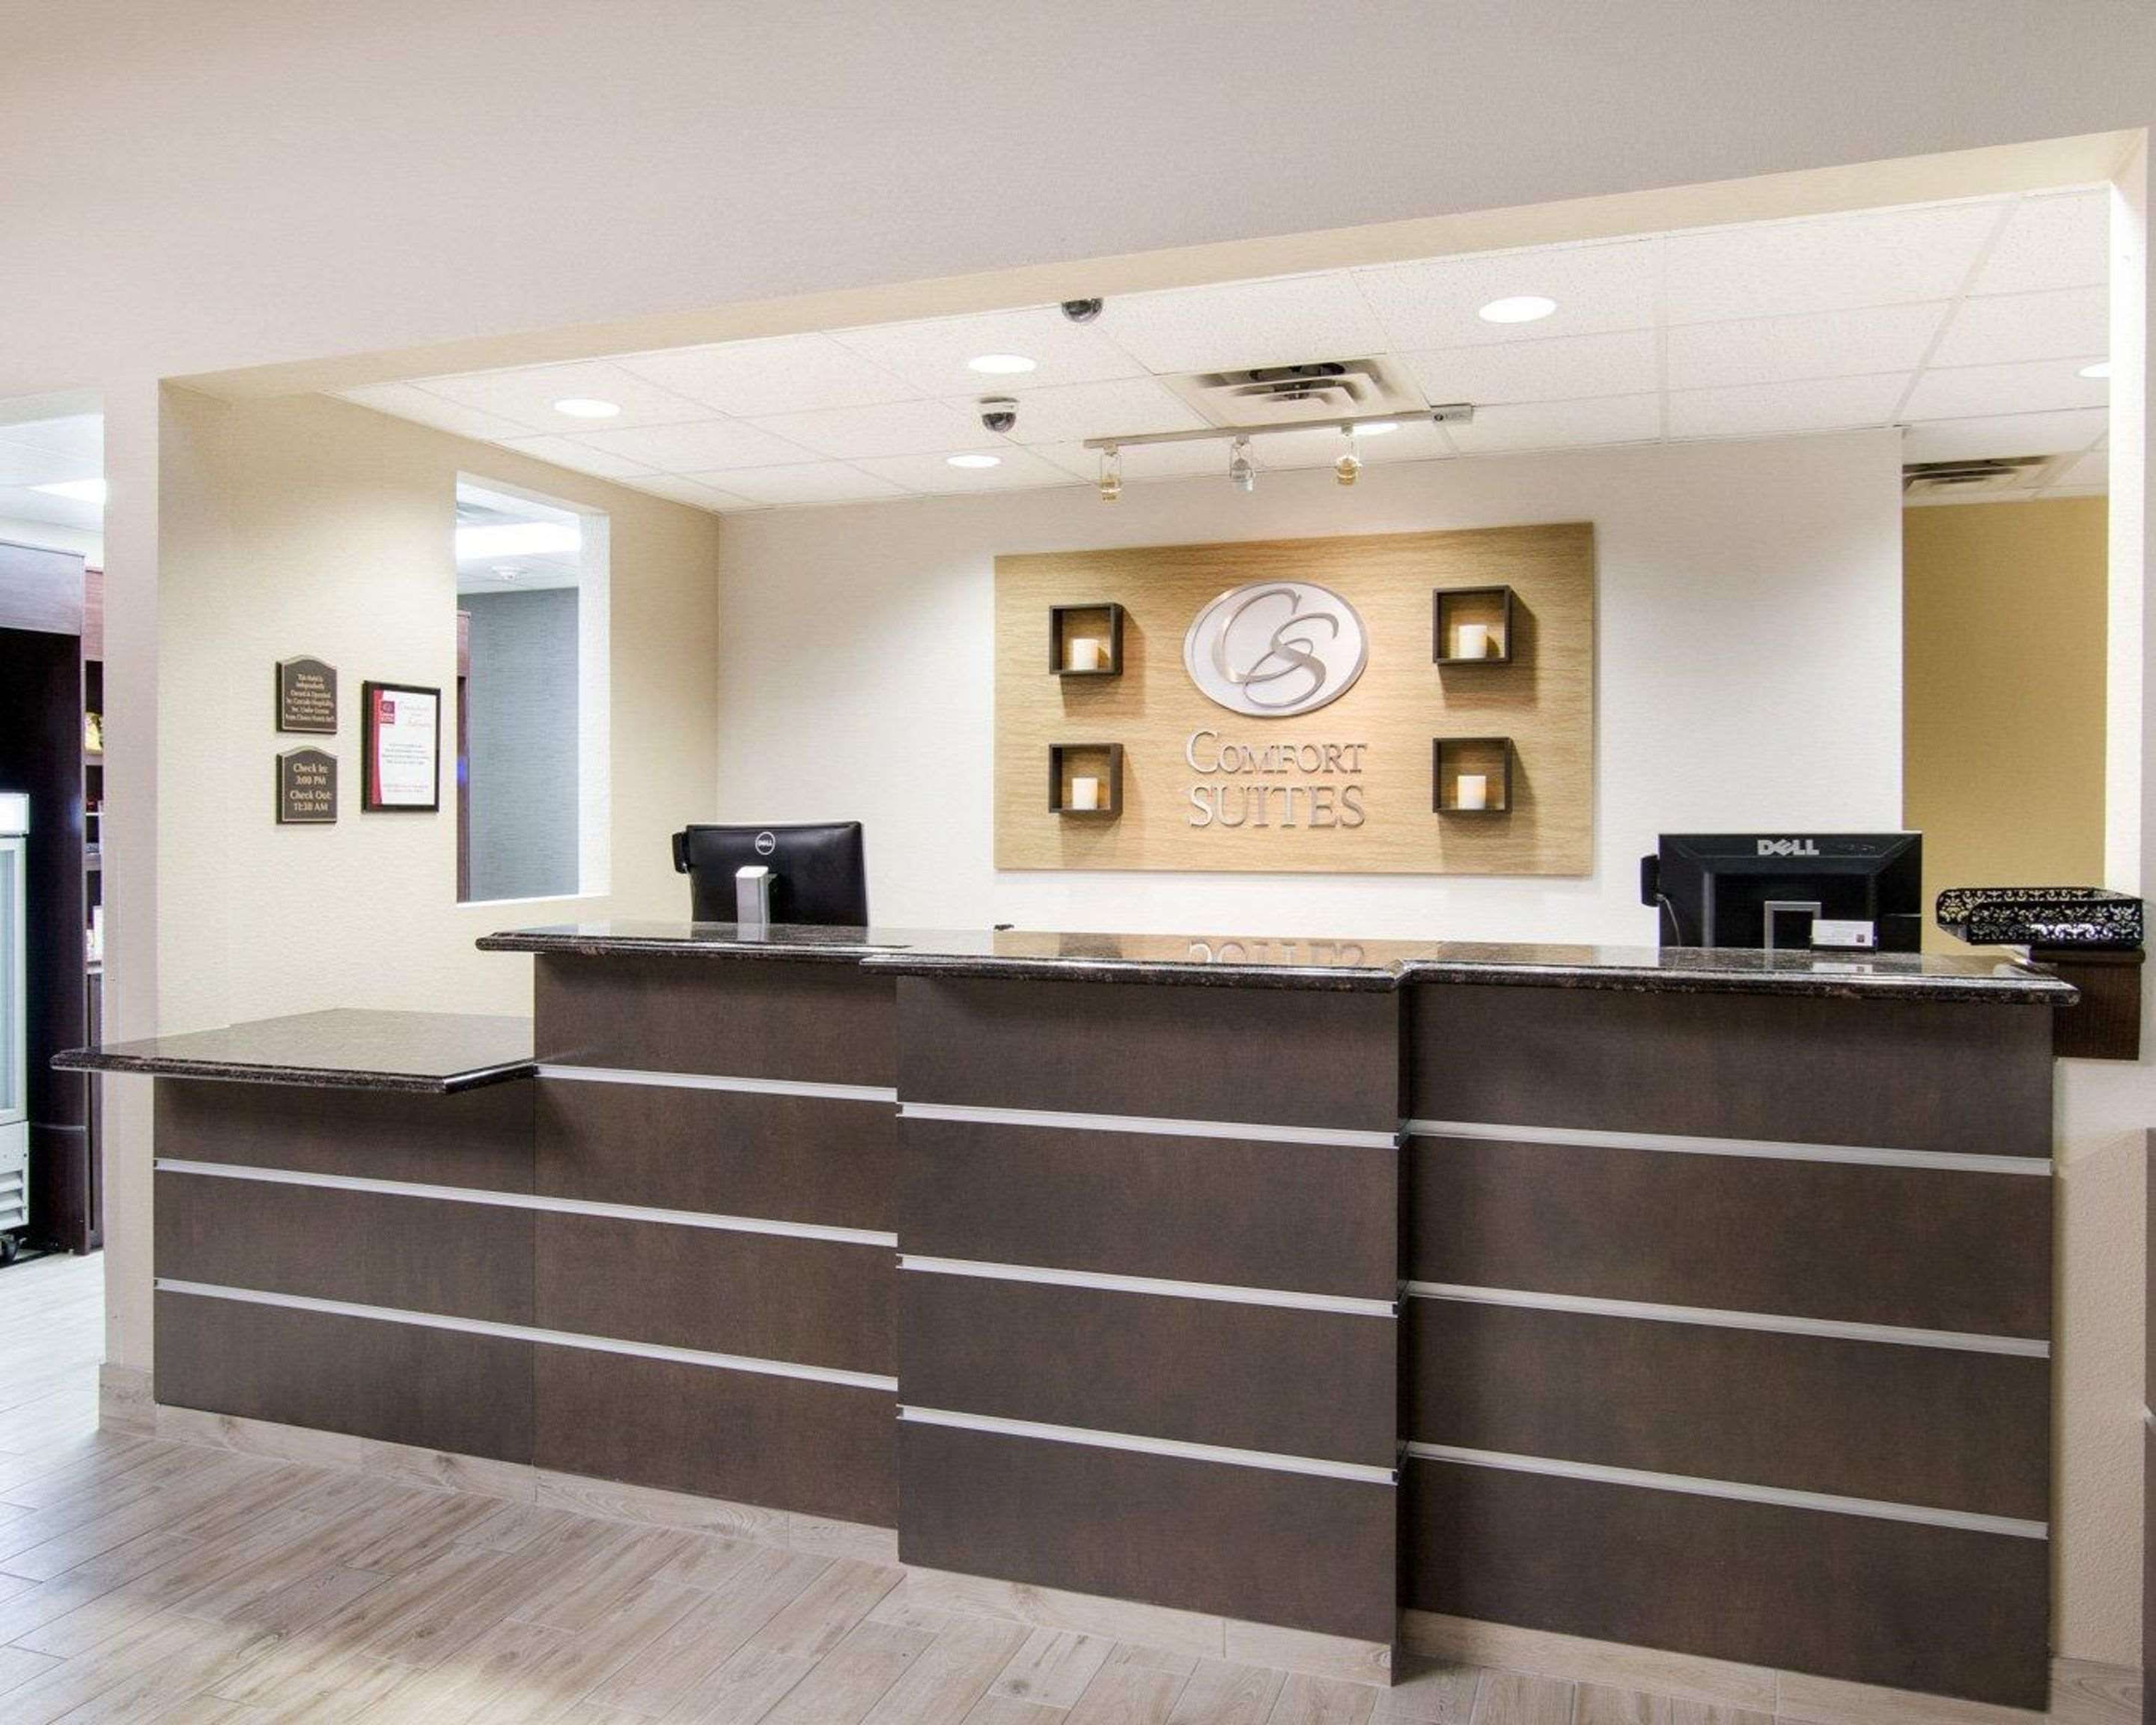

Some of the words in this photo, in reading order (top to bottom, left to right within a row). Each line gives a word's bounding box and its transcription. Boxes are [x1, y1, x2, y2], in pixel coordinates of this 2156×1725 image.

[314, 776, 327, 785] PM
[314, 802, 329, 812] AM
[1190, 785, 1366, 828] SUITES
[1757, 839, 1820, 856] DELL
